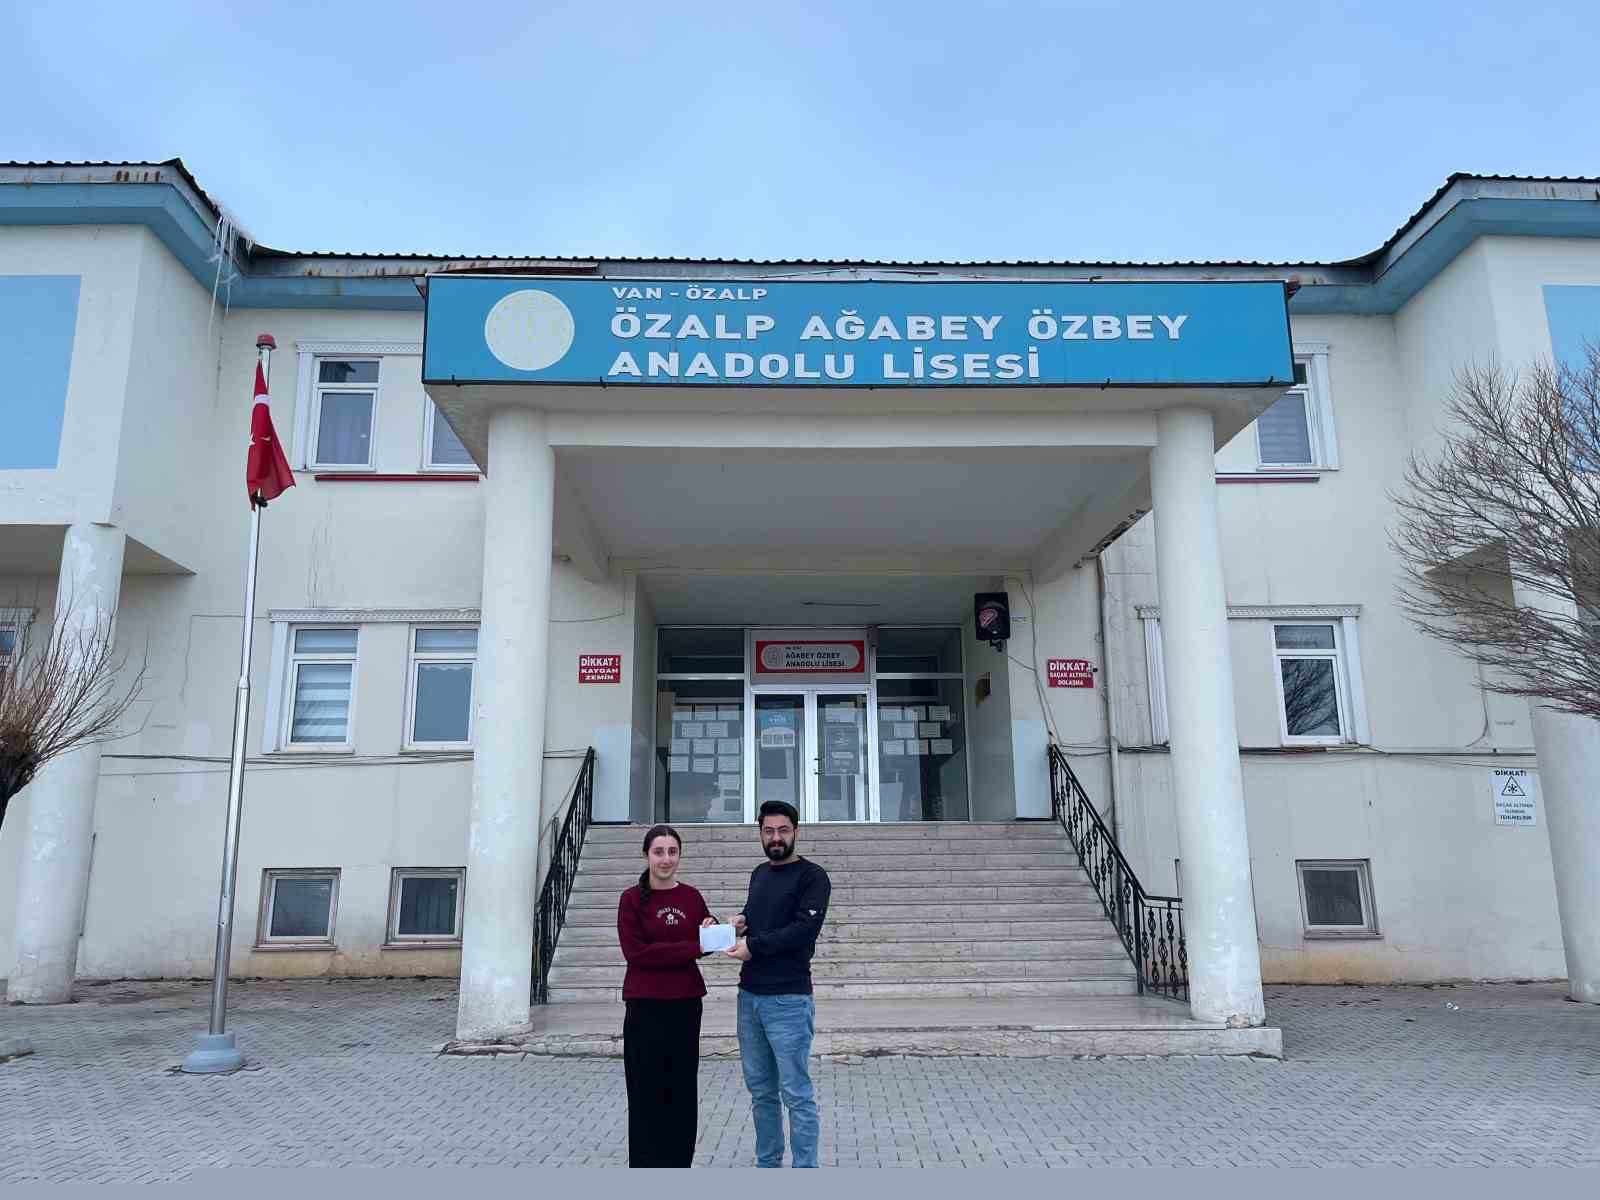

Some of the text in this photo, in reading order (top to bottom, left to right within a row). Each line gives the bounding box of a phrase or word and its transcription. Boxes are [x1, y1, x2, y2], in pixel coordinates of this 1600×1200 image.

[611, 287, 662, 299] VAN
[686, 285, 767, 300] ÖZALP
[611, 307, 1188, 340] ÖZALP AĞABEY ÖZBEY
[607, 346, 1040, 379] ANADOLU LİSESİ
